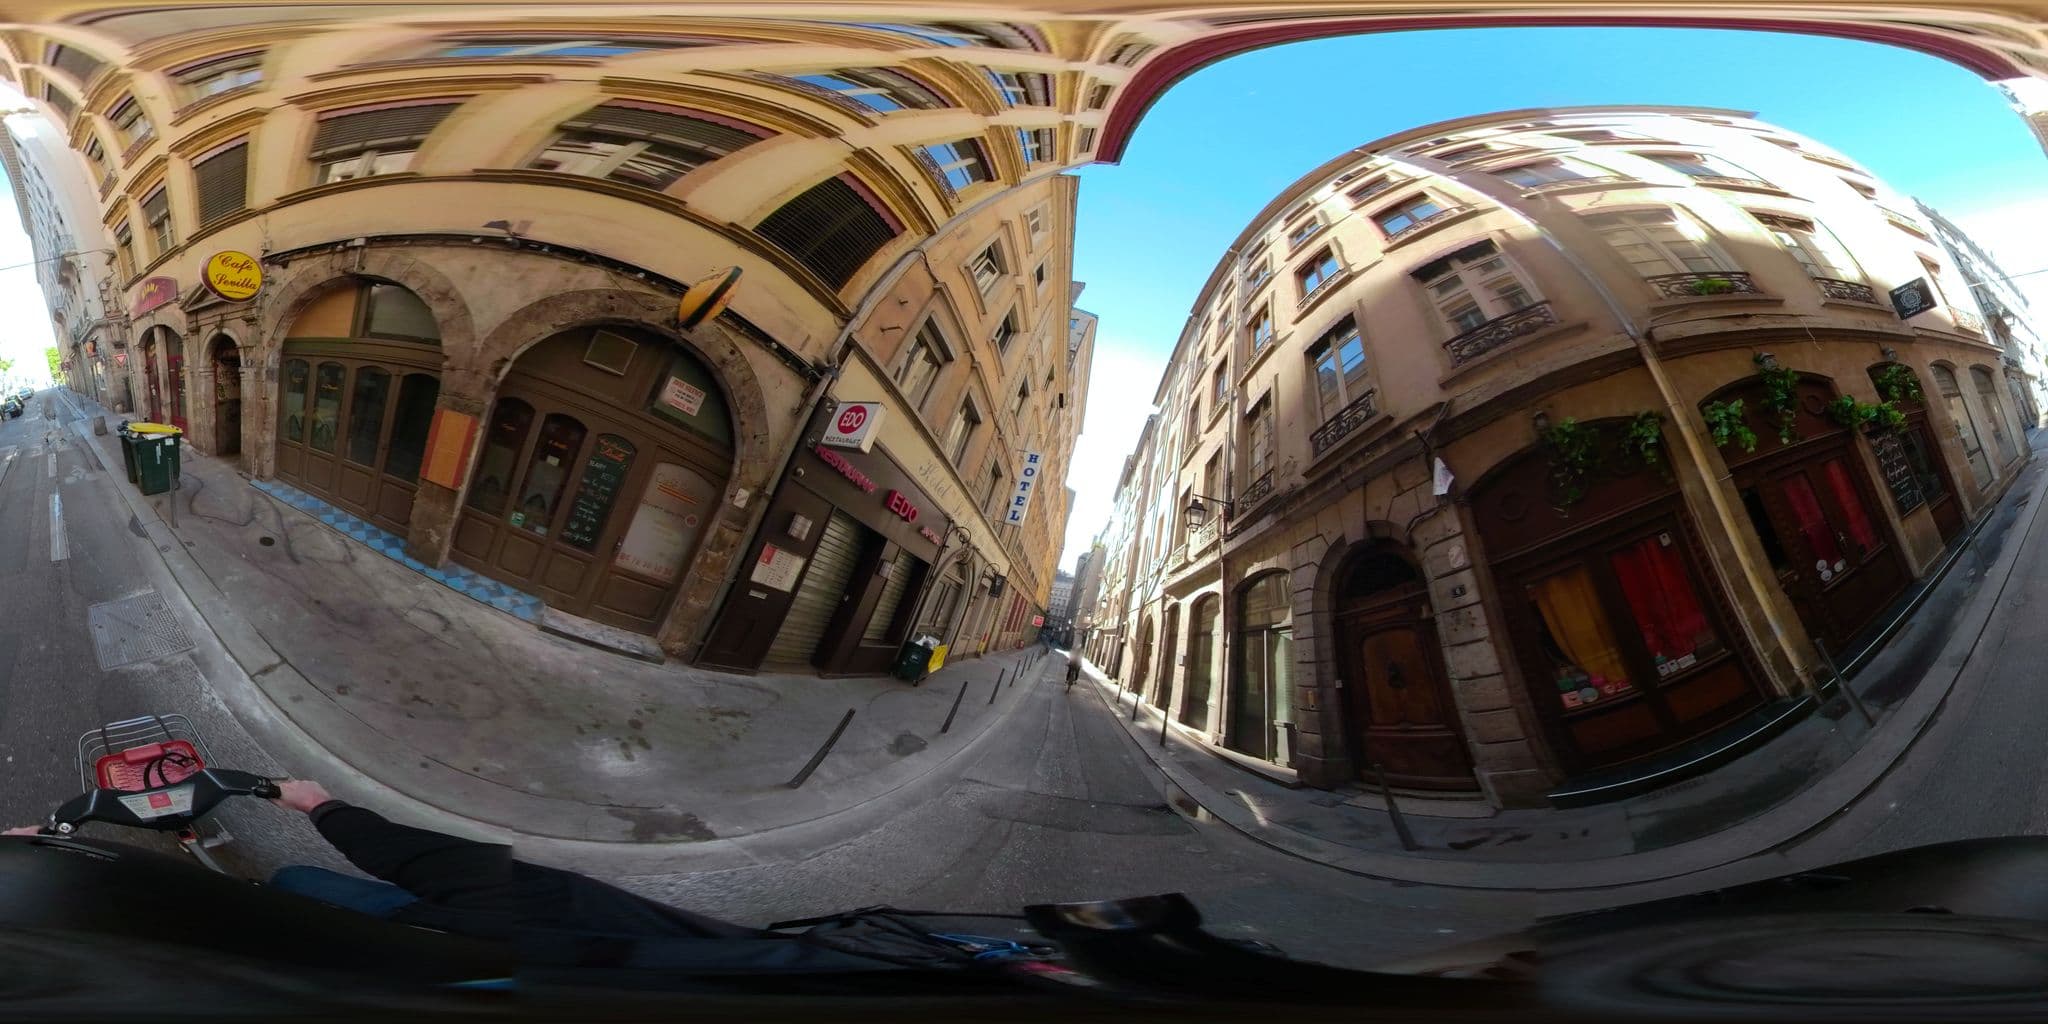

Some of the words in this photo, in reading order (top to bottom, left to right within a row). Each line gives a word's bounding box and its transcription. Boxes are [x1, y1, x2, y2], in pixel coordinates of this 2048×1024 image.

[218, 254, 253, 274] Café
[213, 272, 258, 290] Sevilla
[840, 411, 865, 428] EDO
[1009, 453, 1039, 521] HOTEL
[885, 489, 919, 524] EDO
